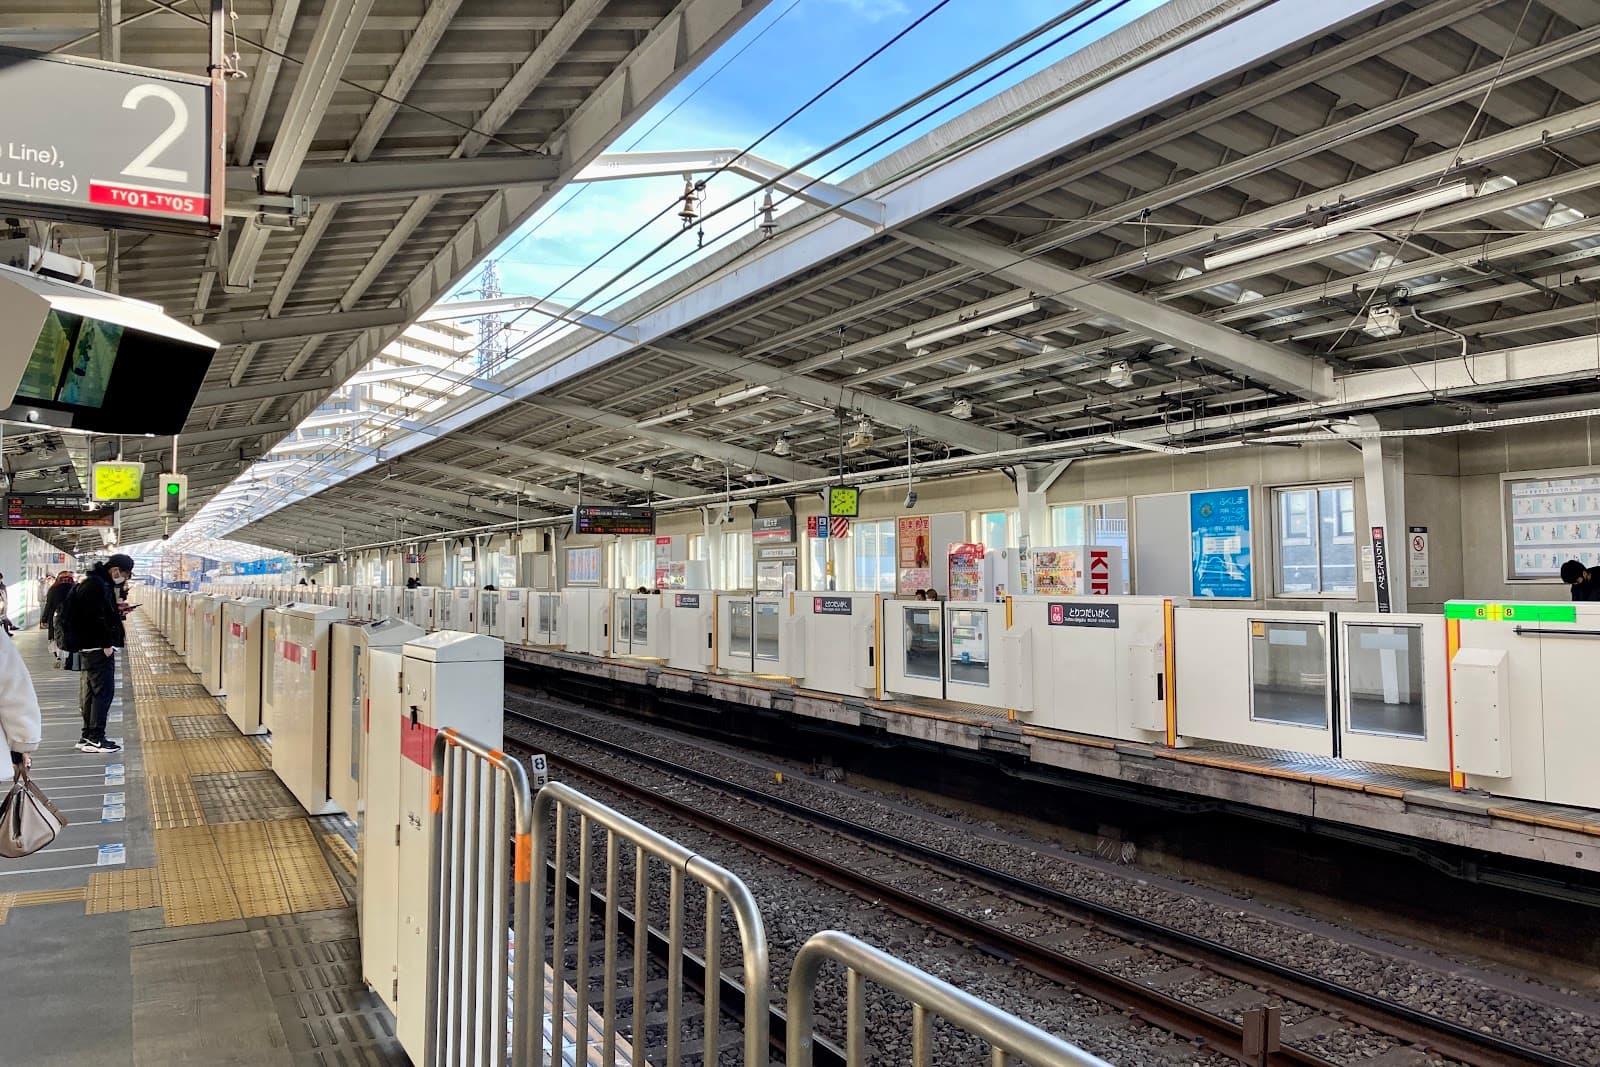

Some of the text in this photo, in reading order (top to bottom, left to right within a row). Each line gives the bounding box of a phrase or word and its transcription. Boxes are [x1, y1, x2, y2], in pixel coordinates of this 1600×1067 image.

[121, 84, 189, 183] 2
[9, 142, 65, 168] Line),
[18, 170, 78, 195] Lines)
[1375, 541, 1385, 590] とりつだいがく
[1069, 607, 1110, 618] とりつだいがく
[535, 758, 544, 770] 8
[538, 776, 544, 784] 5
